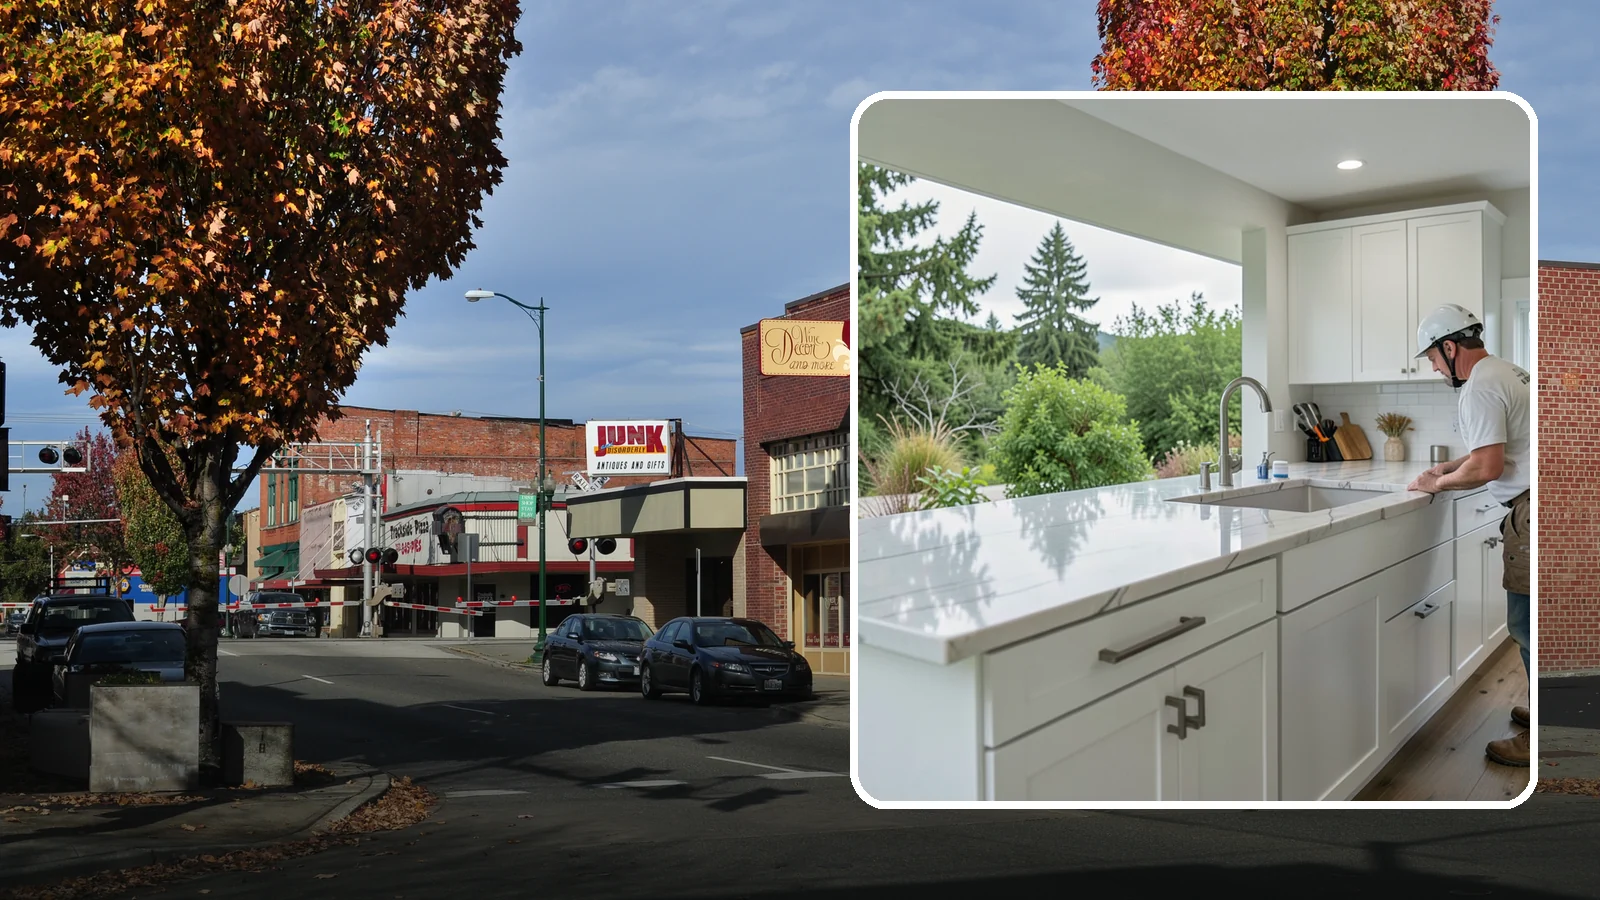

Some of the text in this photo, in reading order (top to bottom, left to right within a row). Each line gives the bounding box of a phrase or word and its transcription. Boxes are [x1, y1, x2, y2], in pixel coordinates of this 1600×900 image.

[765, 327, 831, 366] Decor
[595, 425, 664, 457] JUNK
[607, 446, 645, 454] DISORDERLY
[596, 460, 665, 470] ANTIQUES AND GIFTS
[414, 519, 429, 535] Pizza
